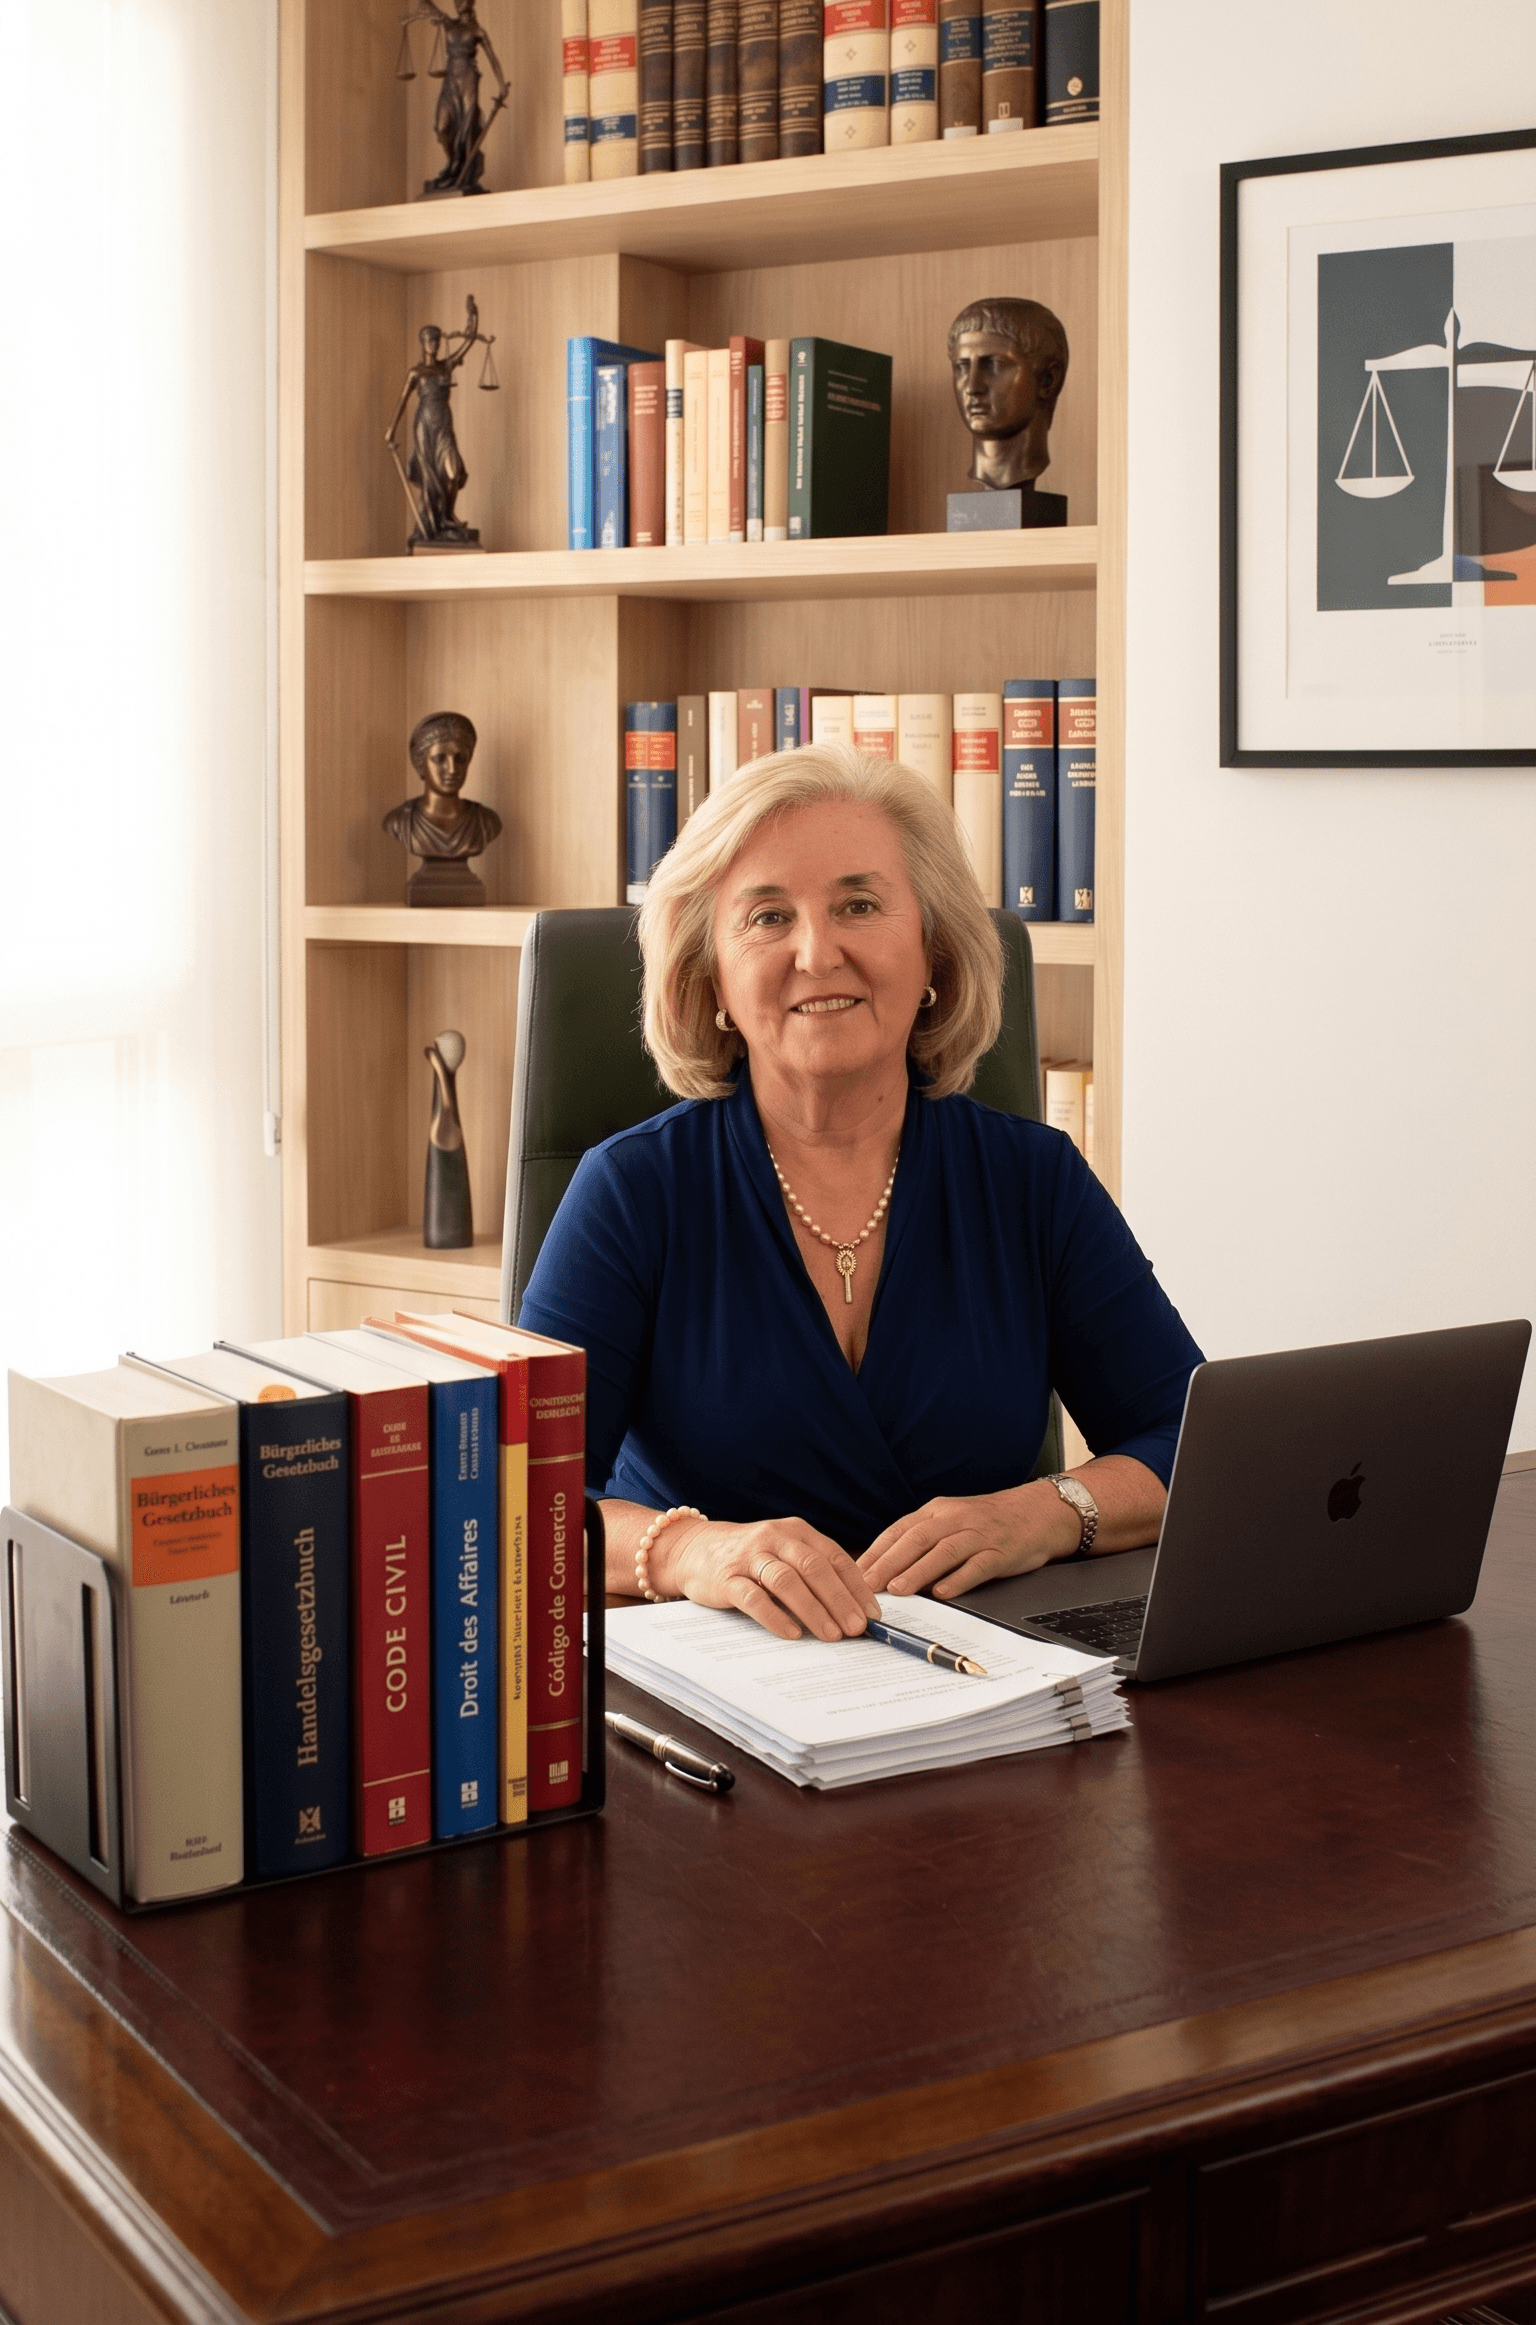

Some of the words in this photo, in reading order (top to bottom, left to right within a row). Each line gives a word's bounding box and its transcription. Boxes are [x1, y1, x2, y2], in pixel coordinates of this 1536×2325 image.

[136, 1483, 236, 1508] Bürgerliches
[386, 1535, 406, 1616] CIVIL
[458, 1518, 478, 1607] Affaires
[549, 1492, 566, 1590] Comercio
[459, 1615, 478, 1653] des
[548, 1595, 566, 1620] de
[294, 1527, 322, 1768] Handelsgesetzbuch
[386, 1627, 407, 1712] CODE
[548, 1624, 570, 1697] Código
[459, 1660, 479, 1718] Droit
